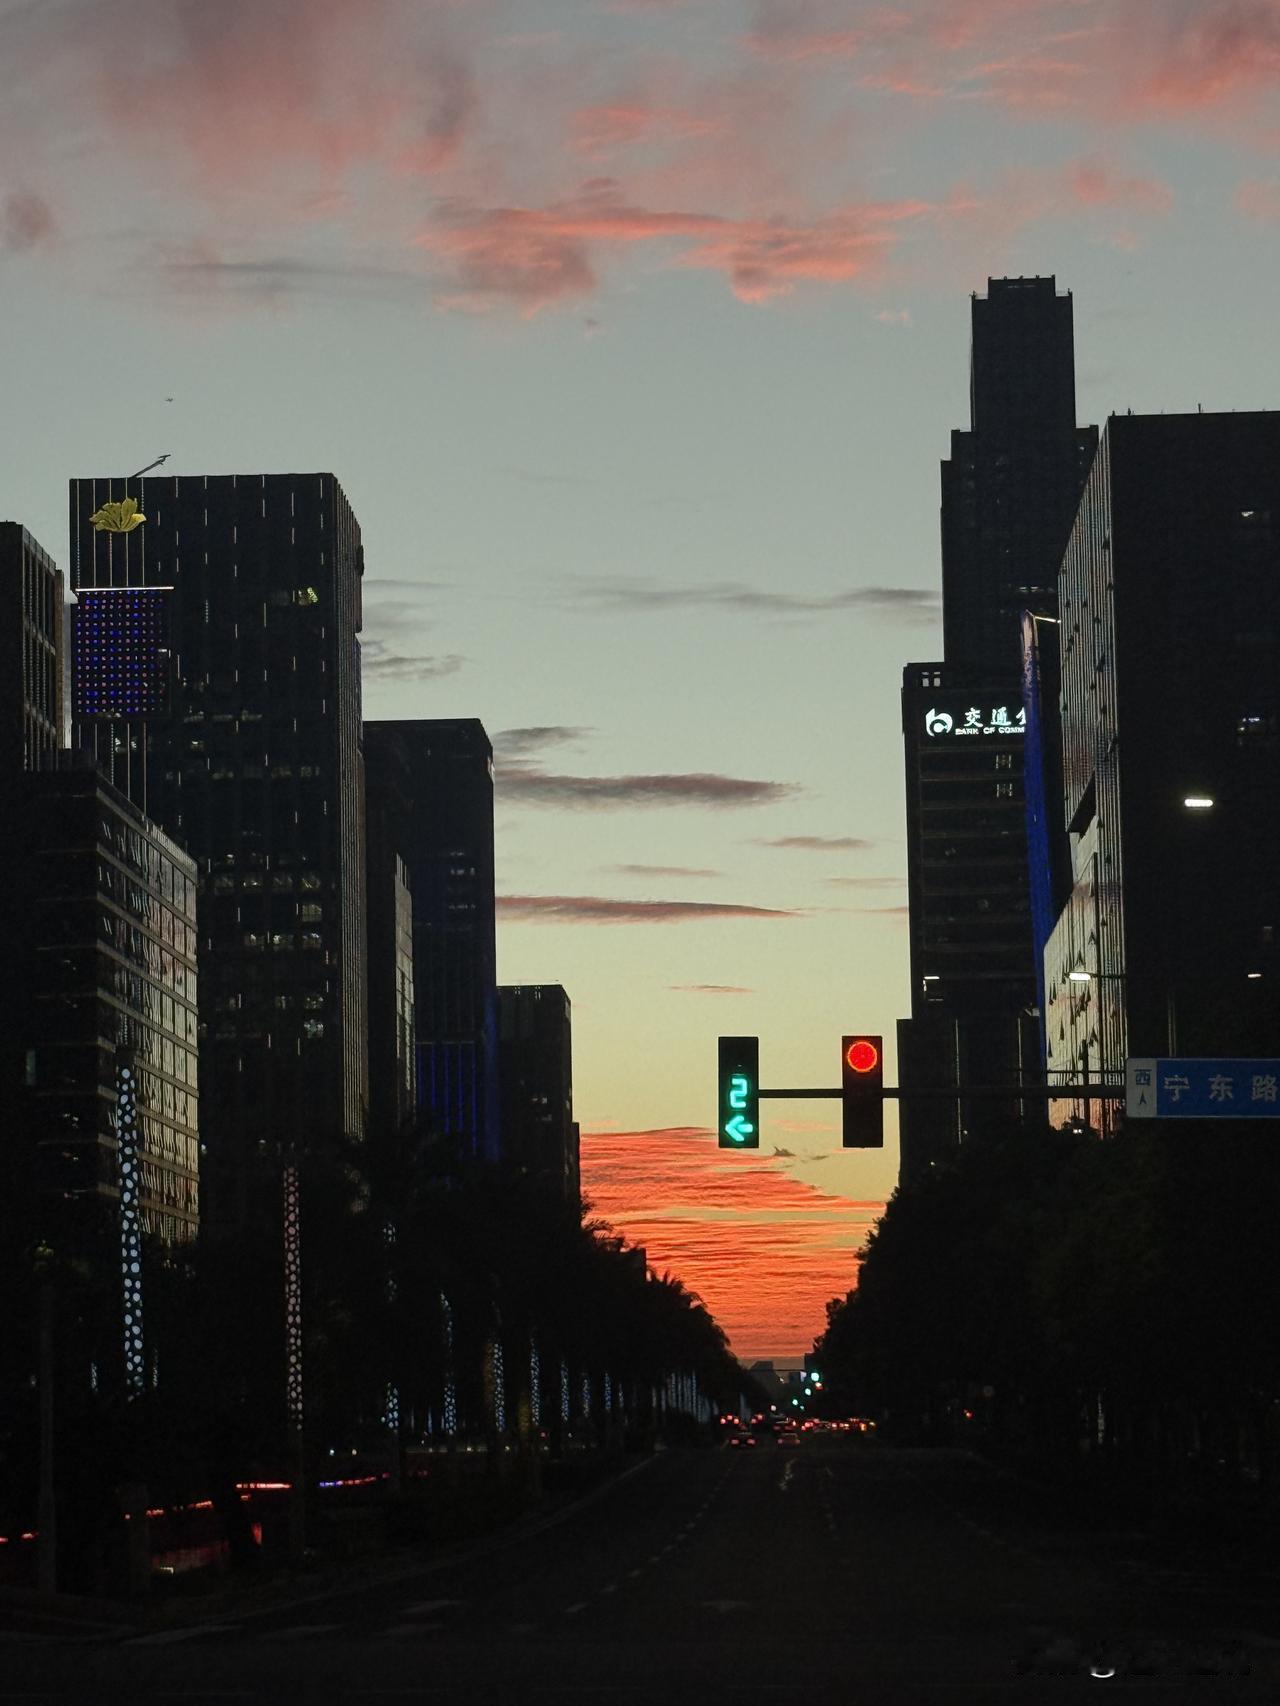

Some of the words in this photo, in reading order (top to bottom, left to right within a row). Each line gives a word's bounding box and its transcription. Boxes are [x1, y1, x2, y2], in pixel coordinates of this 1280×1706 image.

[983, 727, 995, 735] OF
[1134, 1069, 1152, 1086] 西
[1164, 1074, 1278, 1102] 宁东路
[730, 1078, 748, 1108] 2
